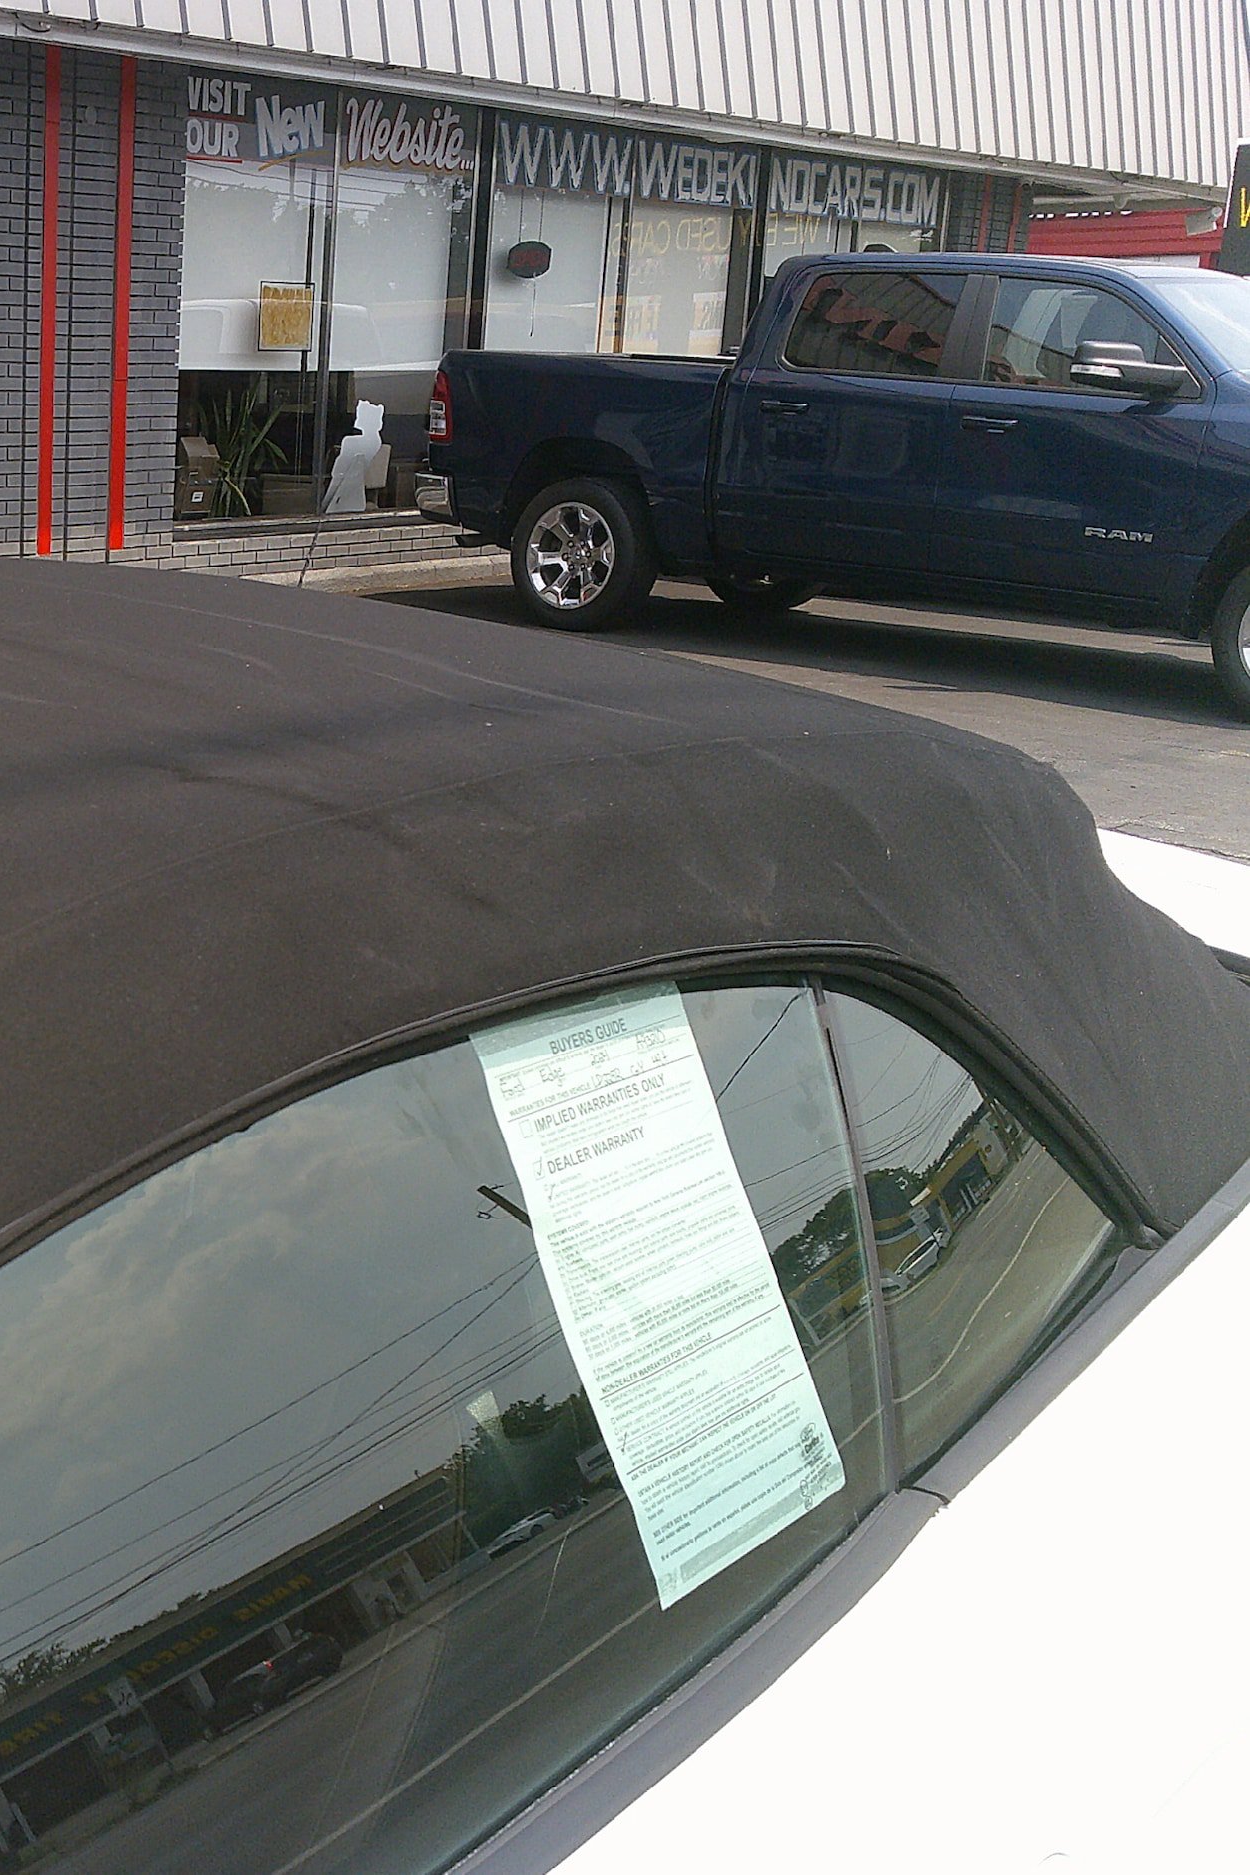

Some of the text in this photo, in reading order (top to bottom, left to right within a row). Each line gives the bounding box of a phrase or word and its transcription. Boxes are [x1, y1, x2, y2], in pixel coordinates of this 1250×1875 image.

[187, 76, 251, 116] VISIT
[186, 118, 240, 157] OUR
[255, 95, 325, 161] New
[1084, 526, 1153, 543] RAM
[550, 1018, 627, 1055] BUYERS GUIDE
[534, 1072, 666, 1133] IMPLIED WARRANTIES ONLY
[547, 1126, 646, 1175] DEALER WARRANTY
